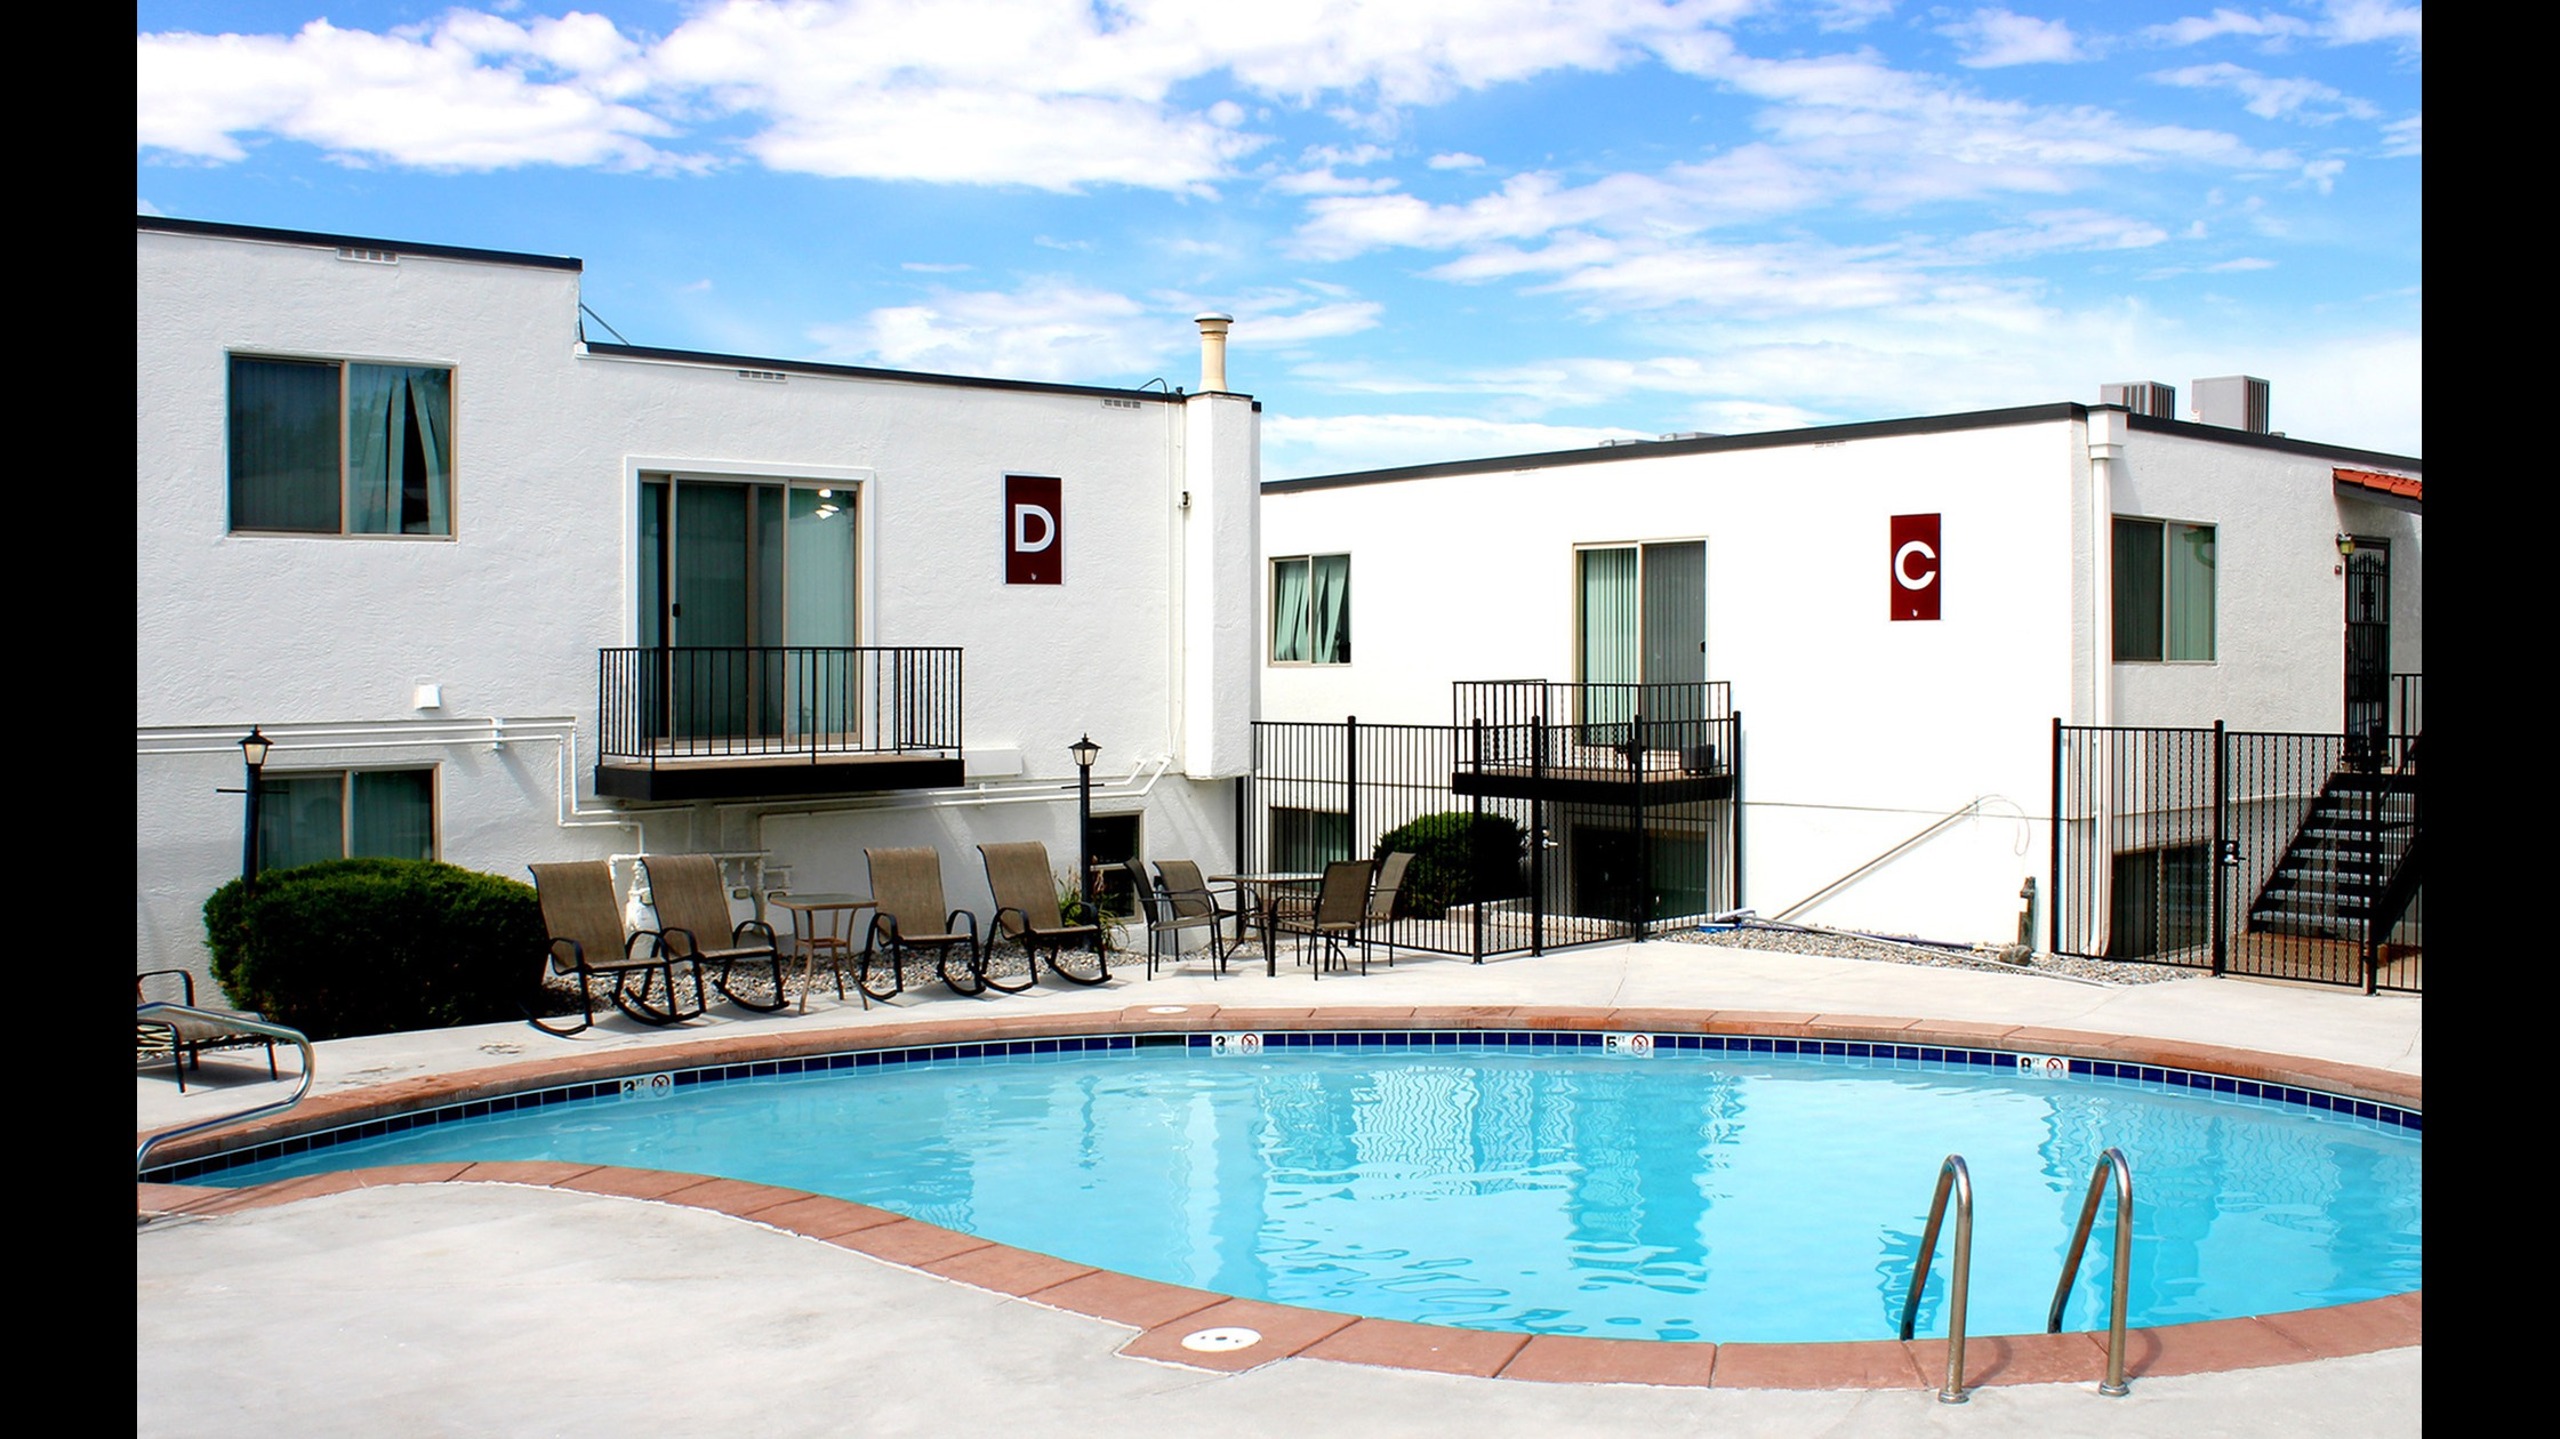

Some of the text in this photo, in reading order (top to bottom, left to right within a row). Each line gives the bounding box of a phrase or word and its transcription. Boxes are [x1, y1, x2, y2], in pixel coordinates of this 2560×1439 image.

[1015, 504, 1055, 552] D
[1894, 540, 1936, 590] C
[1606, 1035, 1617, 1048] 5
